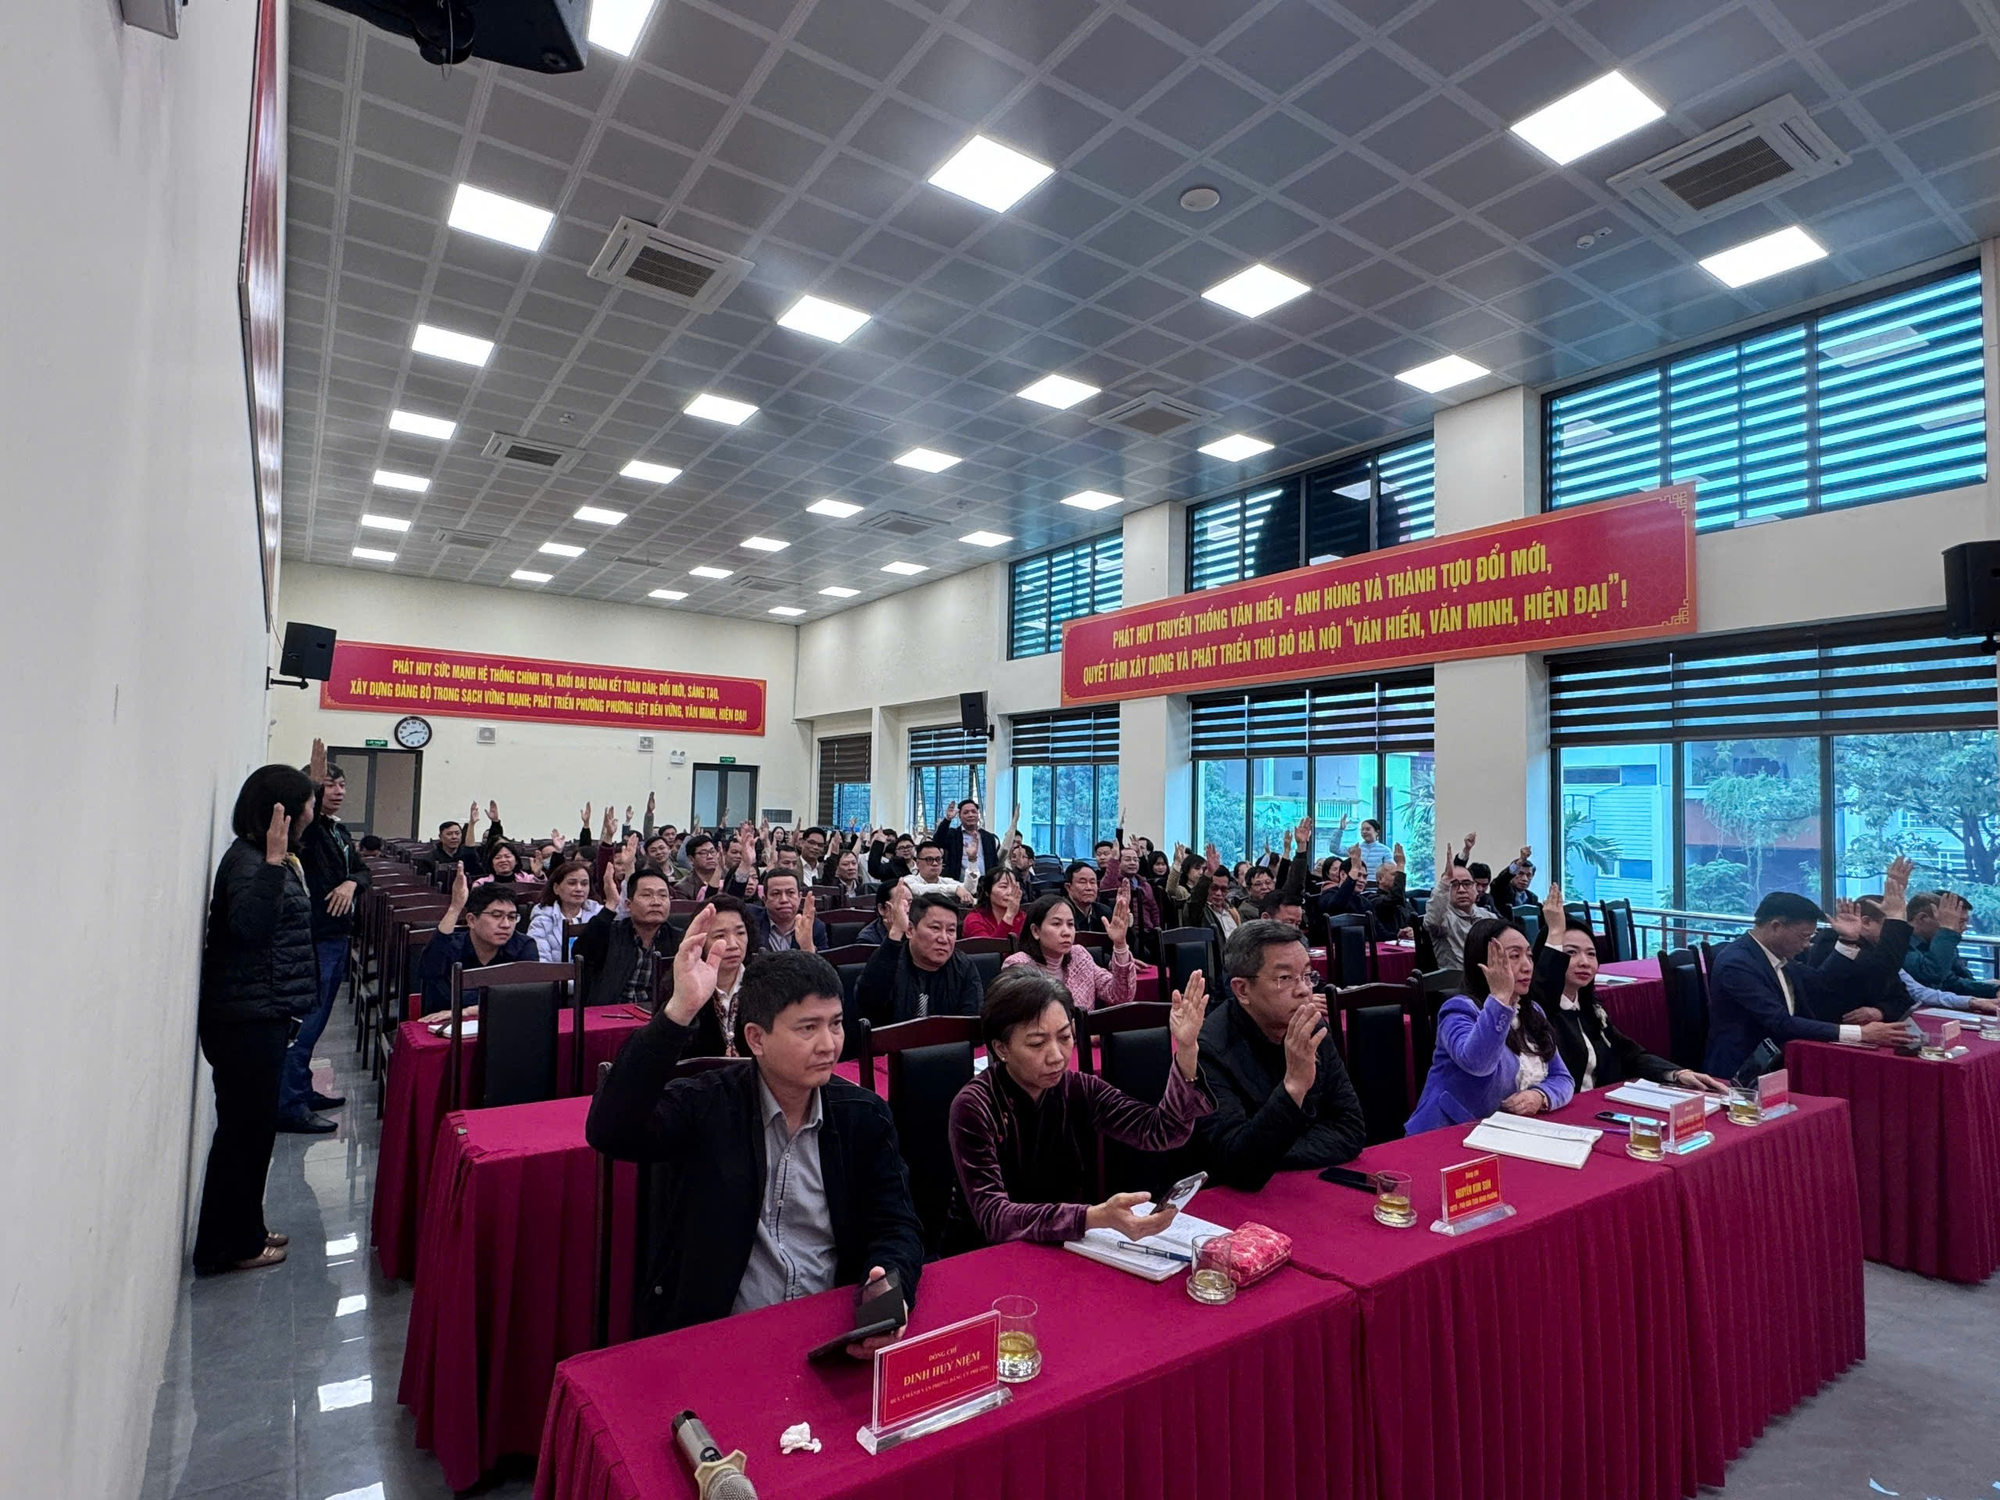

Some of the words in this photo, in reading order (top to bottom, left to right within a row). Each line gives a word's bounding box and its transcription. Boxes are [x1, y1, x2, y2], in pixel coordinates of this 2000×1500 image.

[1113, 625, 1135, 649] PHÁT
[1136, 623, 1154, 645] HUY
[1194, 604, 1228, 634] THỐNG
[1230, 601, 1253, 628] VĂN
[1255, 592, 1283, 623] HIẾN
[1294, 590, 1320, 616] ANH
[1324, 581, 1360, 610] HÙNG
[1364, 573, 1383, 603] VÀ
[1386, 566, 1436, 599] THÀNH
[1441, 557, 1471, 593] TỰU
[1476, 543, 1505, 583] ĐỔI
[1511, 540, 1552, 576] MỚI,
[1083, 658, 1108, 687] QUYẾT
[1110, 657, 1127, 681] TÂM
[1129, 654, 1147, 678] XÂY
[1148, 652, 1174, 679] DỰNG
[1176, 646, 1189, 671] VÀ
[1191, 643, 1217, 669] PHÁT
[1219, 633, 1251, 665] TRIỂN
[1254, 629, 1276, 660] THỦ
[1279, 628, 1295, 657] ĐÔ
[1298, 625, 1316, 654] HÀ
[1319, 621, 1342, 654] NỘI
[1385, 605, 1425, 641] HIẾN,
[1429, 602, 1462, 635] VĂN
[1467, 597, 1518, 630] MINH,
[1524, 586, 1568, 625] HIỆN
[350, 677, 368, 695] XÂY
[369, 681, 393, 699] DỰNG
[395, 679, 418, 699] ĐẢNG
[420, 682, 432, 703] BỘ
[433, 686, 460, 702] TRONG
[461, 688, 482, 706] SẠCH
[533, 692, 552, 708] PHÁT
[635, 700, 649, 718] LIỆT
[392, 657, 414, 674] PHÁT
[416, 661, 433, 676] HUY
[434, 660, 450, 678] SỨC
[452, 664, 476, 682] MẠNH
[478, 665, 488, 684] HỆ
[490, 665, 515, 684] THỐNG
[516, 669, 540, 686] CHÍNH
[556, 671, 574, 688] KHỐI
[575, 675, 587, 692] ĐẠI
[588, 675, 608, 691] ĐOÀN
[609, 675, 622, 692] KẾT
[623, 678, 640, 694] TOÀN
[687, 683, 705, 699] SÁNG
[932, 1361, 955, 1377] HUY
[955, 1351, 981, 1368] NIỆM
